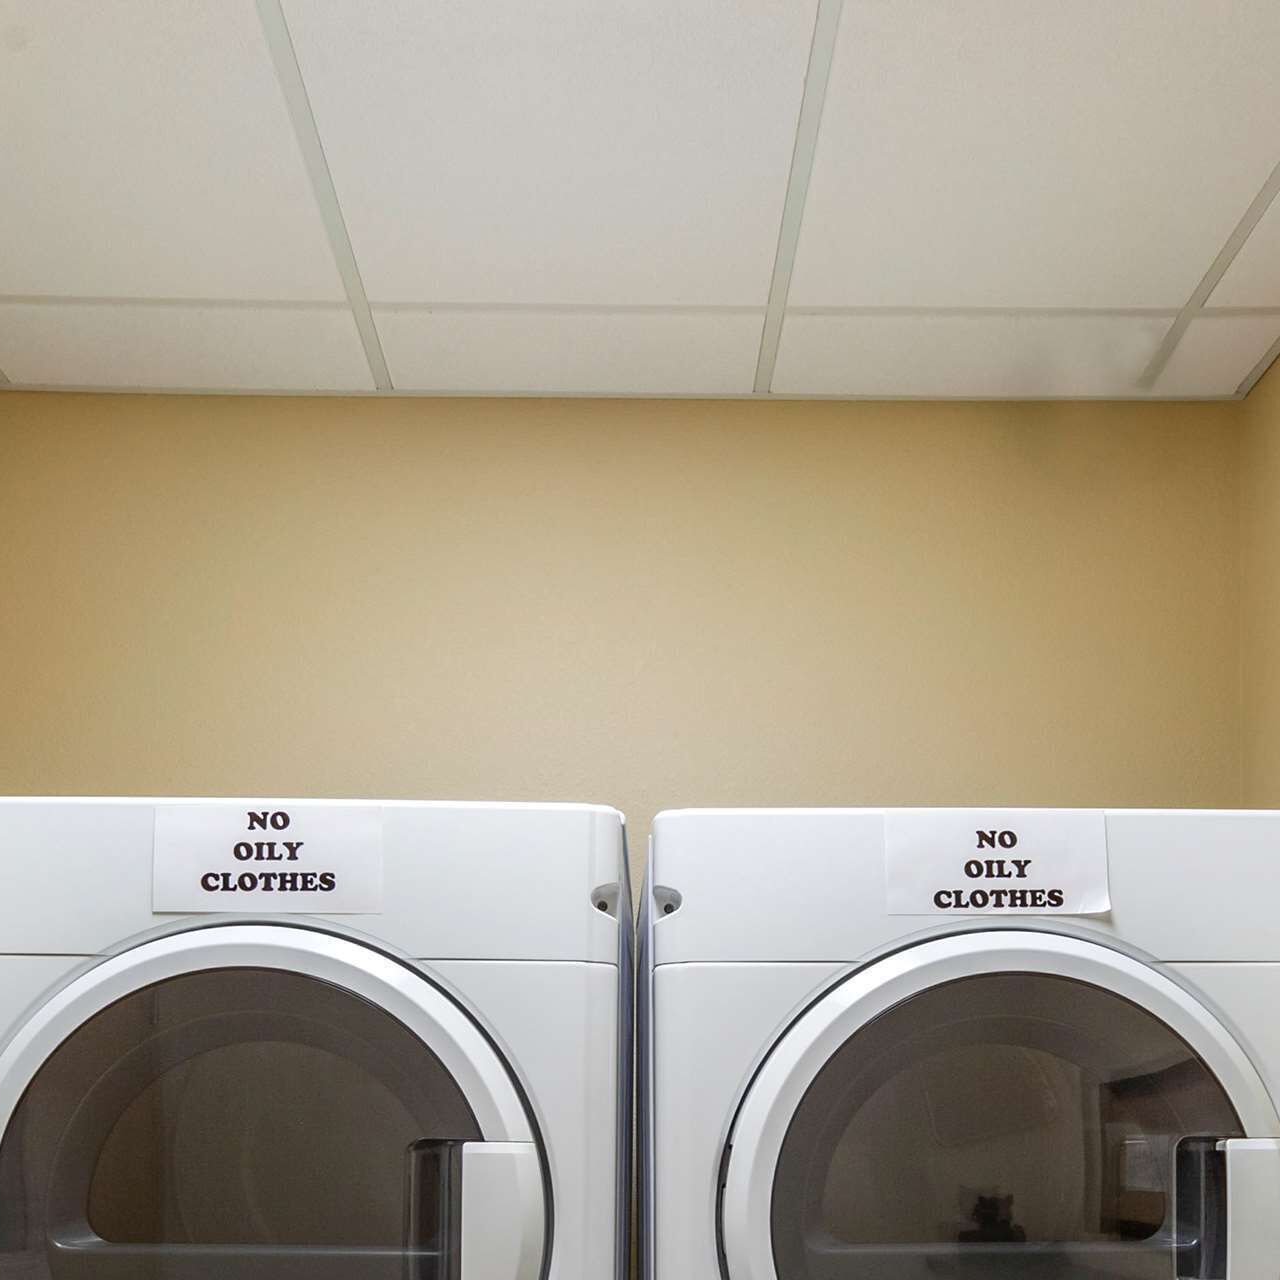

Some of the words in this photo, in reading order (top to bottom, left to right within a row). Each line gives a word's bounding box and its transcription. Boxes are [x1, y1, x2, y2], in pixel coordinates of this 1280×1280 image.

[247, 811, 290, 830] NO
[976, 830, 1017, 849] NO
[233, 842, 304, 861] OILY
[964, 860, 1032, 878] OILY
[200, 872, 336, 892] CLOTHES
[933, 889, 1064, 909] CLOTHES
